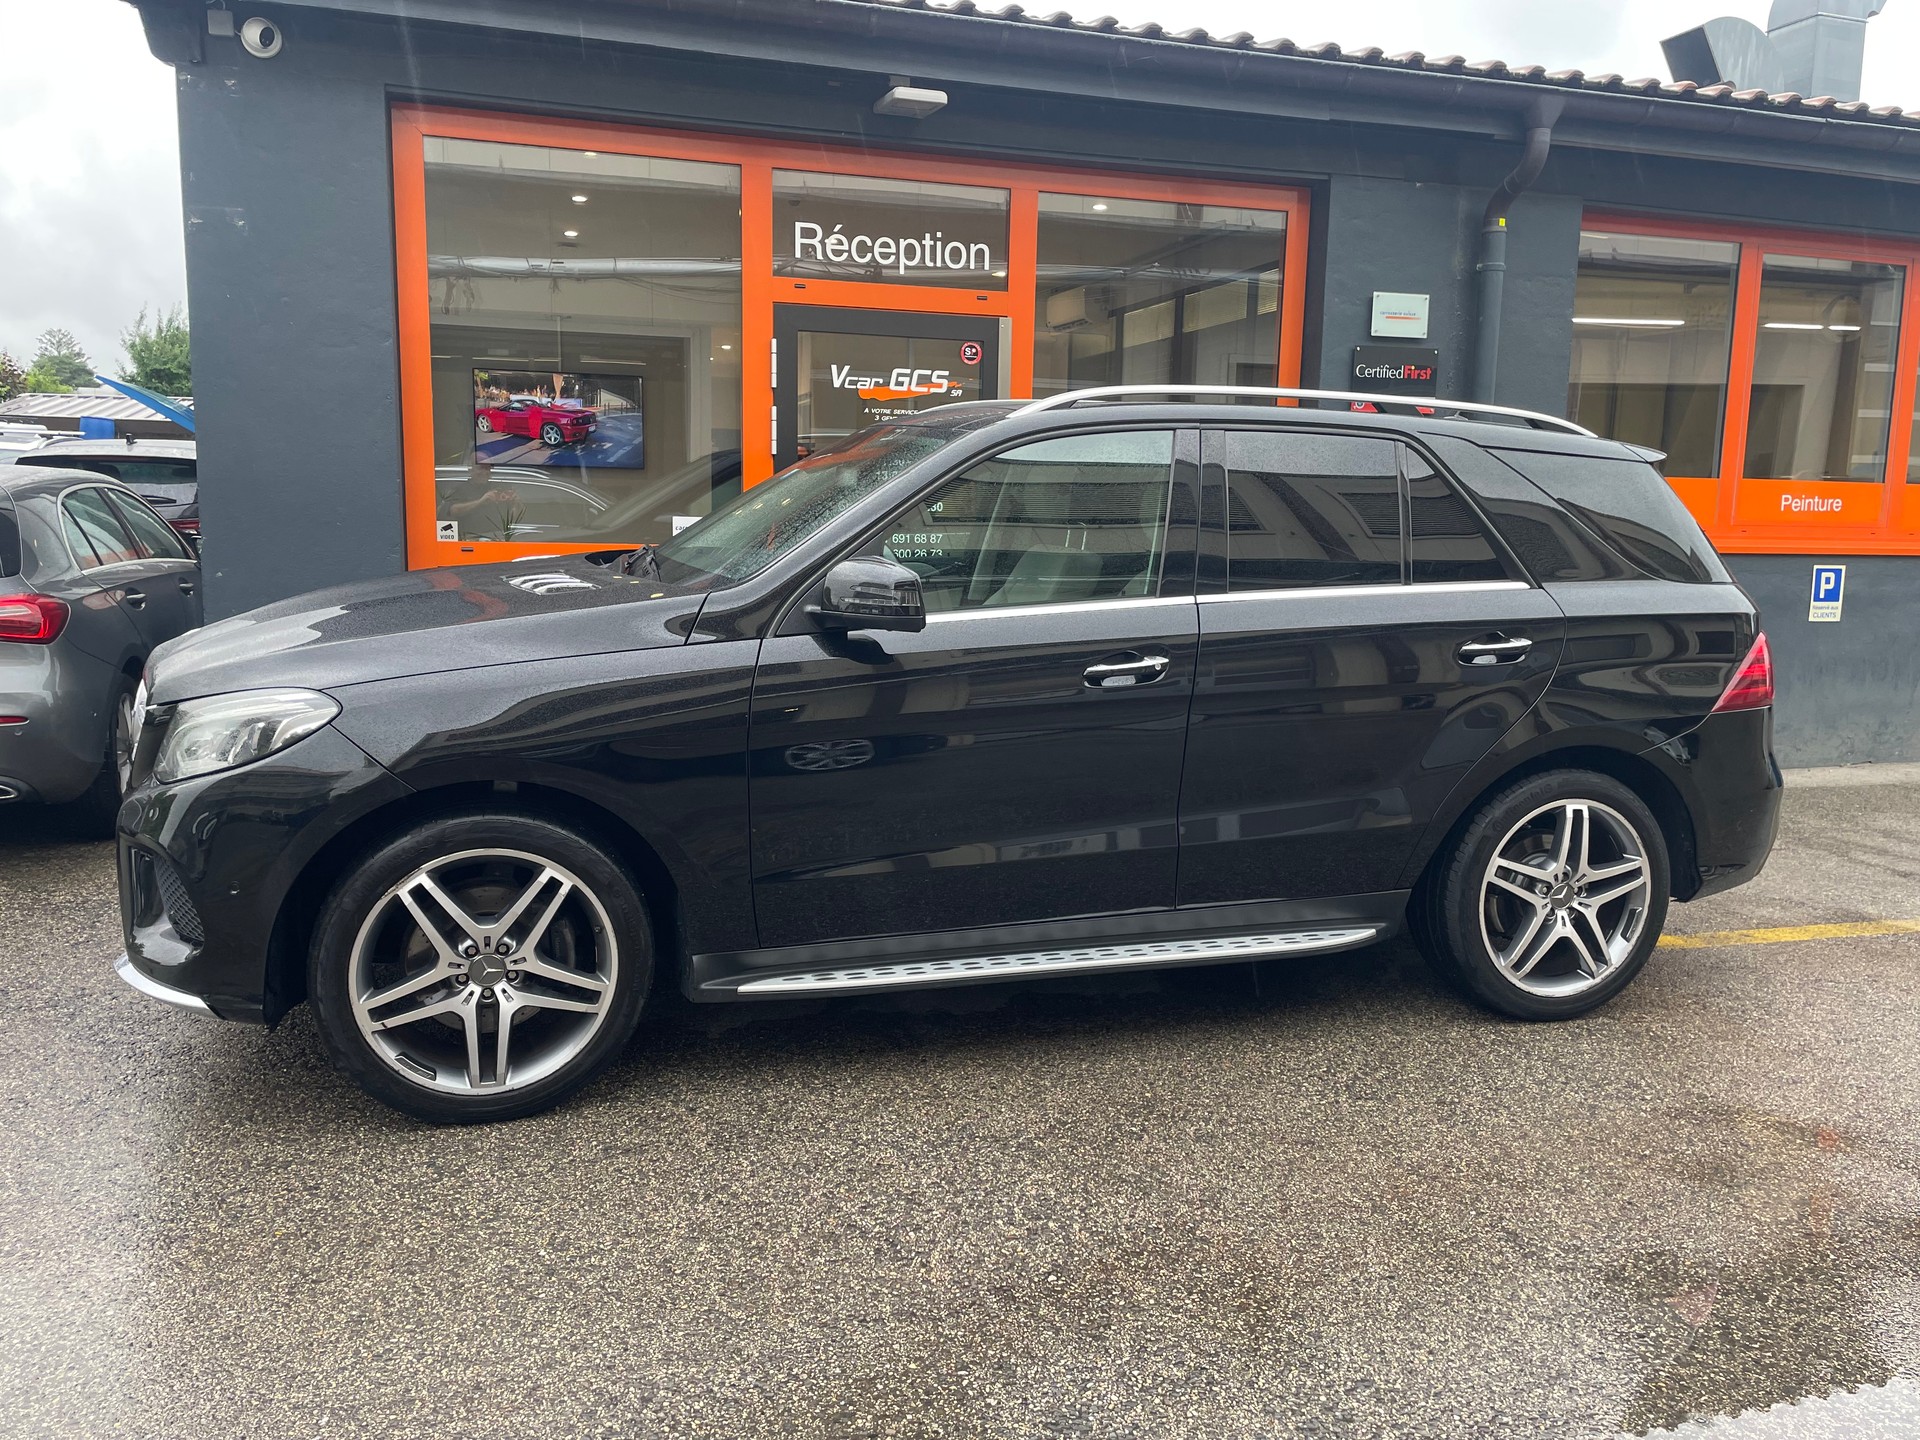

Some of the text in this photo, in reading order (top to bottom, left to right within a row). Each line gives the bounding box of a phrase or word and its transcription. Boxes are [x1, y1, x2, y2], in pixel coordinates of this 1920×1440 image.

[794, 221, 990, 275] Réception
[831, 364, 949, 393] Vcar GCS
[950, 389, 963, 397] SA
[1780, 494, 1843, 512] Peinture
[892, 533, 911, 544] 691
[914, 533, 928, 544] 68
[929, 533, 943, 544] 87
[914, 549, 928, 558] 26
[1819, 571, 1836, 599] P
